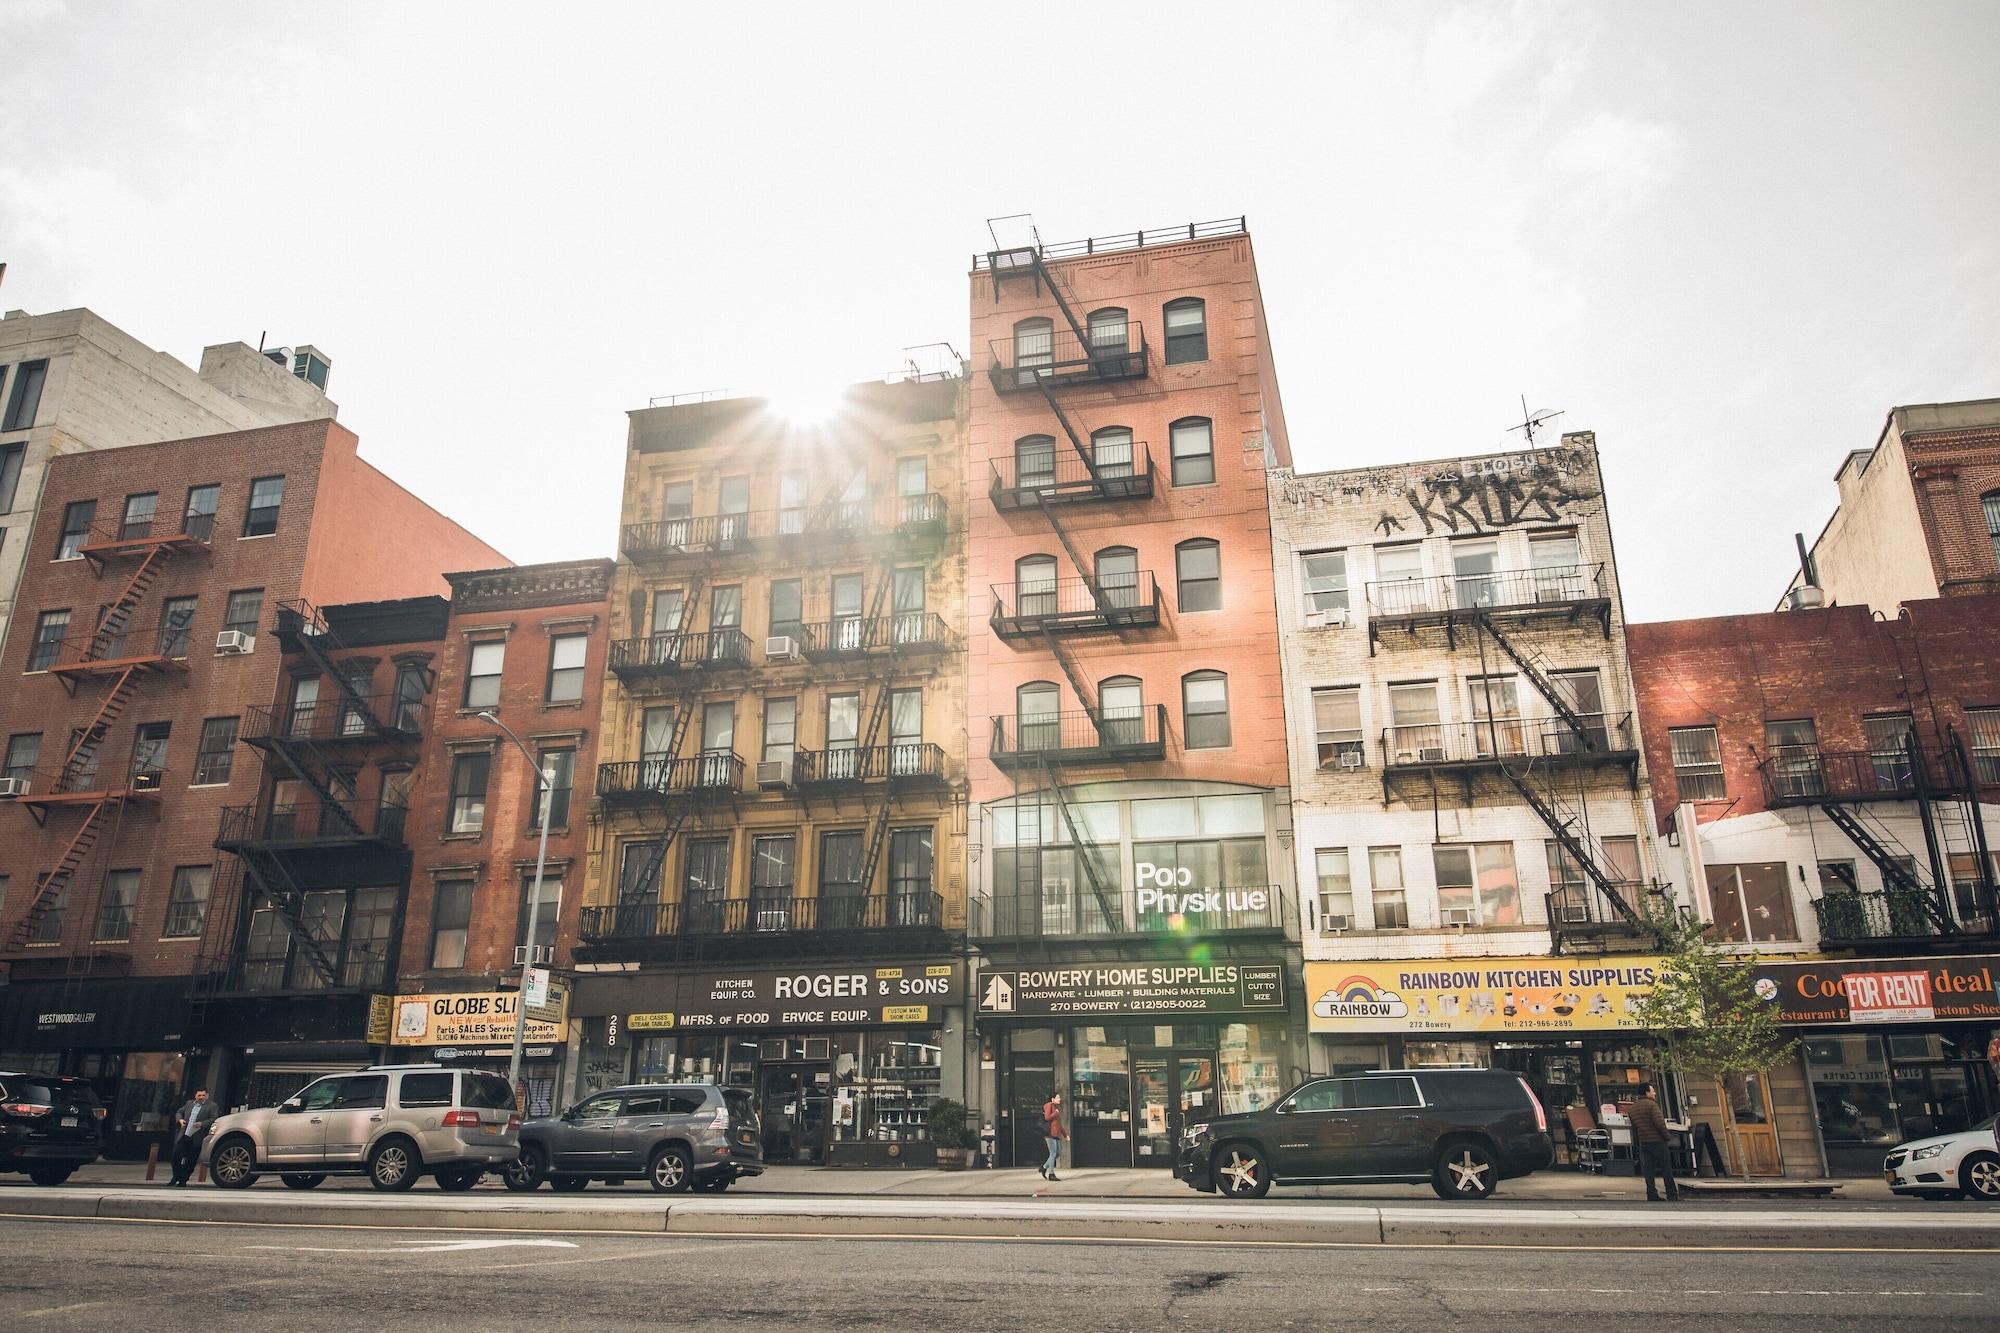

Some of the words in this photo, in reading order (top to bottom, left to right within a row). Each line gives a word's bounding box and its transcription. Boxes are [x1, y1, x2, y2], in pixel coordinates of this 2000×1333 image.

[1136, 862, 1192, 891] Pop
[1137, 886, 1267, 918] Physique
[1019, 970, 1093, 988] BOWERY
[1096, 968, 1148, 986] HOME
[1151, 966, 1238, 984] SUPPLIES
[1244, 972, 1277, 980] LUMBER
[1400, 971, 1480, 990] RAINBOW
[1486, 969, 1563, 988] KITCHEN
[1569, 967, 1656, 986] SUPPLIES
[1934, 967, 1994, 993] deal
[715, 979, 753, 989] KITCHEN
[775, 974, 868, 998] ROGER
[878, 980, 890, 995] &
[899, 978, 949, 995] SONS
[1264, 982, 1276, 990] TO
[710, 991, 738, 1000] EQUIP.
[741, 990, 757, 999] CO.
[1021, 990, 1076, 999] HARDWARE
[1084, 989, 1124, 998] LUMBER
[1132, 988, 1178, 996] BUILDING
[1180, 986, 1236, 996] MATERIALS
[1253, 993, 1271, 1001] SIZE
[1846, 976, 1882, 1008] FOR
[1881, 974, 1927, 1006] RENT
[434, 997, 490, 1015] GLOBE
[494, 997, 517, 1014] SLI
[1050, 1002, 1070, 1011] 270
[1072, 1002, 1120, 1011] BOWERY
[1130, 999, 1207, 1010] (212)505-0022
[1329, 1004, 1391, 1016] RAINBOW
[1934, 1005, 1969, 1016] ustom
[450, 1015, 472, 1025] NEW
[487, 1014, 518, 1024] Rebuilt
[680, 1014, 716, 1026] MFRS.
[736, 1012, 769, 1024] FOOD
[782, 1011, 824, 1023] ERVICE
[830, 1010, 871, 1022] EQUIP.
[436, 1025, 455, 1034] Parts
[458, 1024, 486, 1033] SALES
[489, 1024, 515, 1033] Servic
[608, 1014, 618, 1046] 268
[1425, 1021, 1452, 1029] Bowery
[436, 1033, 458, 1041] SLICING
[460, 1032, 489, 1041] Machines
[490, 1032, 515, 1040] Mixers
